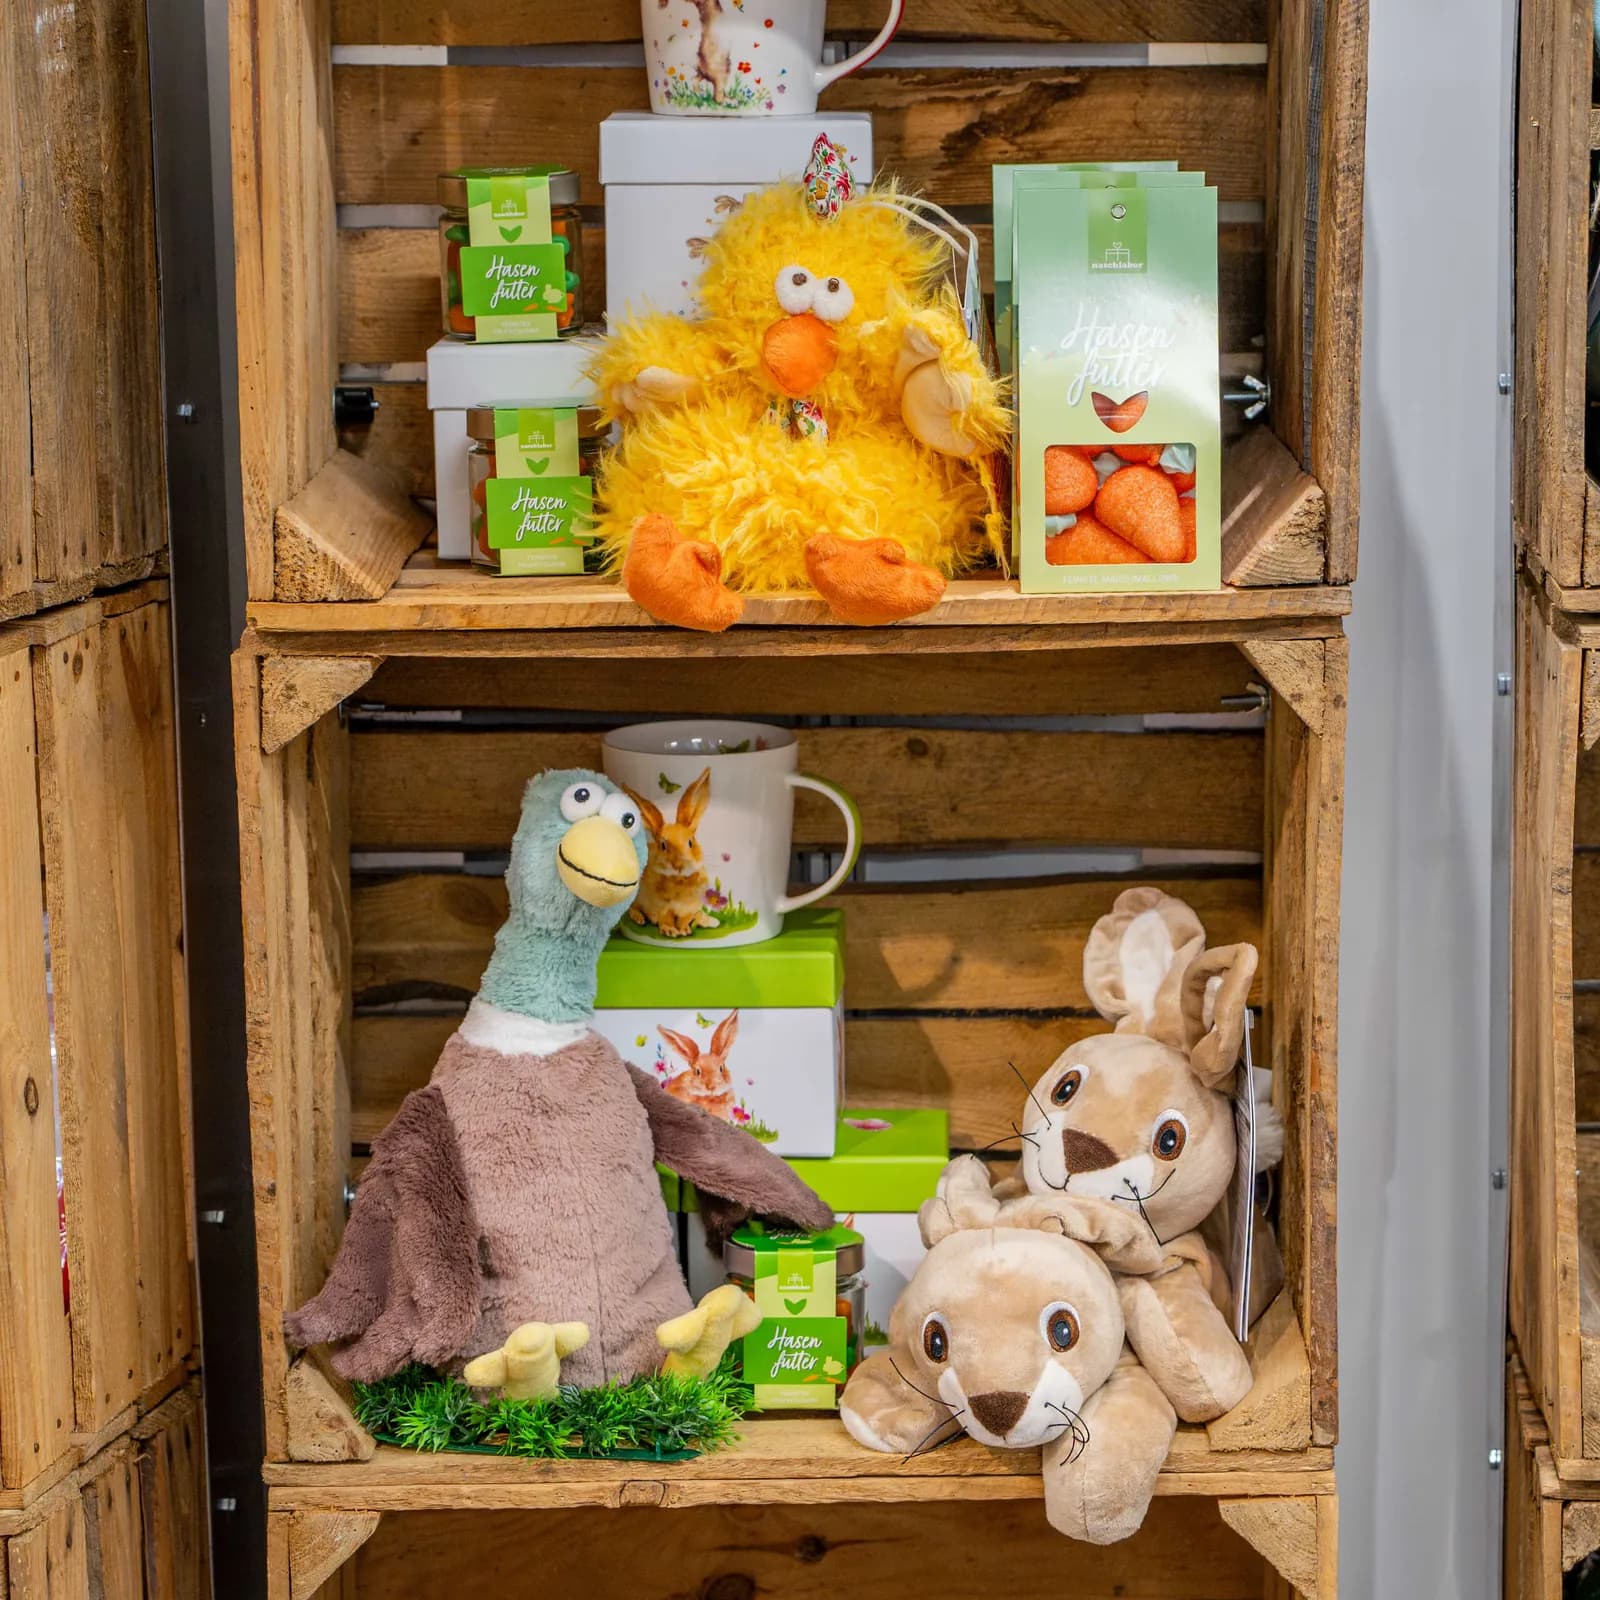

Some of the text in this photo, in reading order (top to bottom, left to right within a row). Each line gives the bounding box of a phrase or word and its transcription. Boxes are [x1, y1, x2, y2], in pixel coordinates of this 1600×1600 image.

[485, 254, 541, 281] Hasen
[1060, 301, 1177, 353] Hasen
[511, 486, 568, 512] Hasen
[767, 1325, 823, 1351] Hasen
